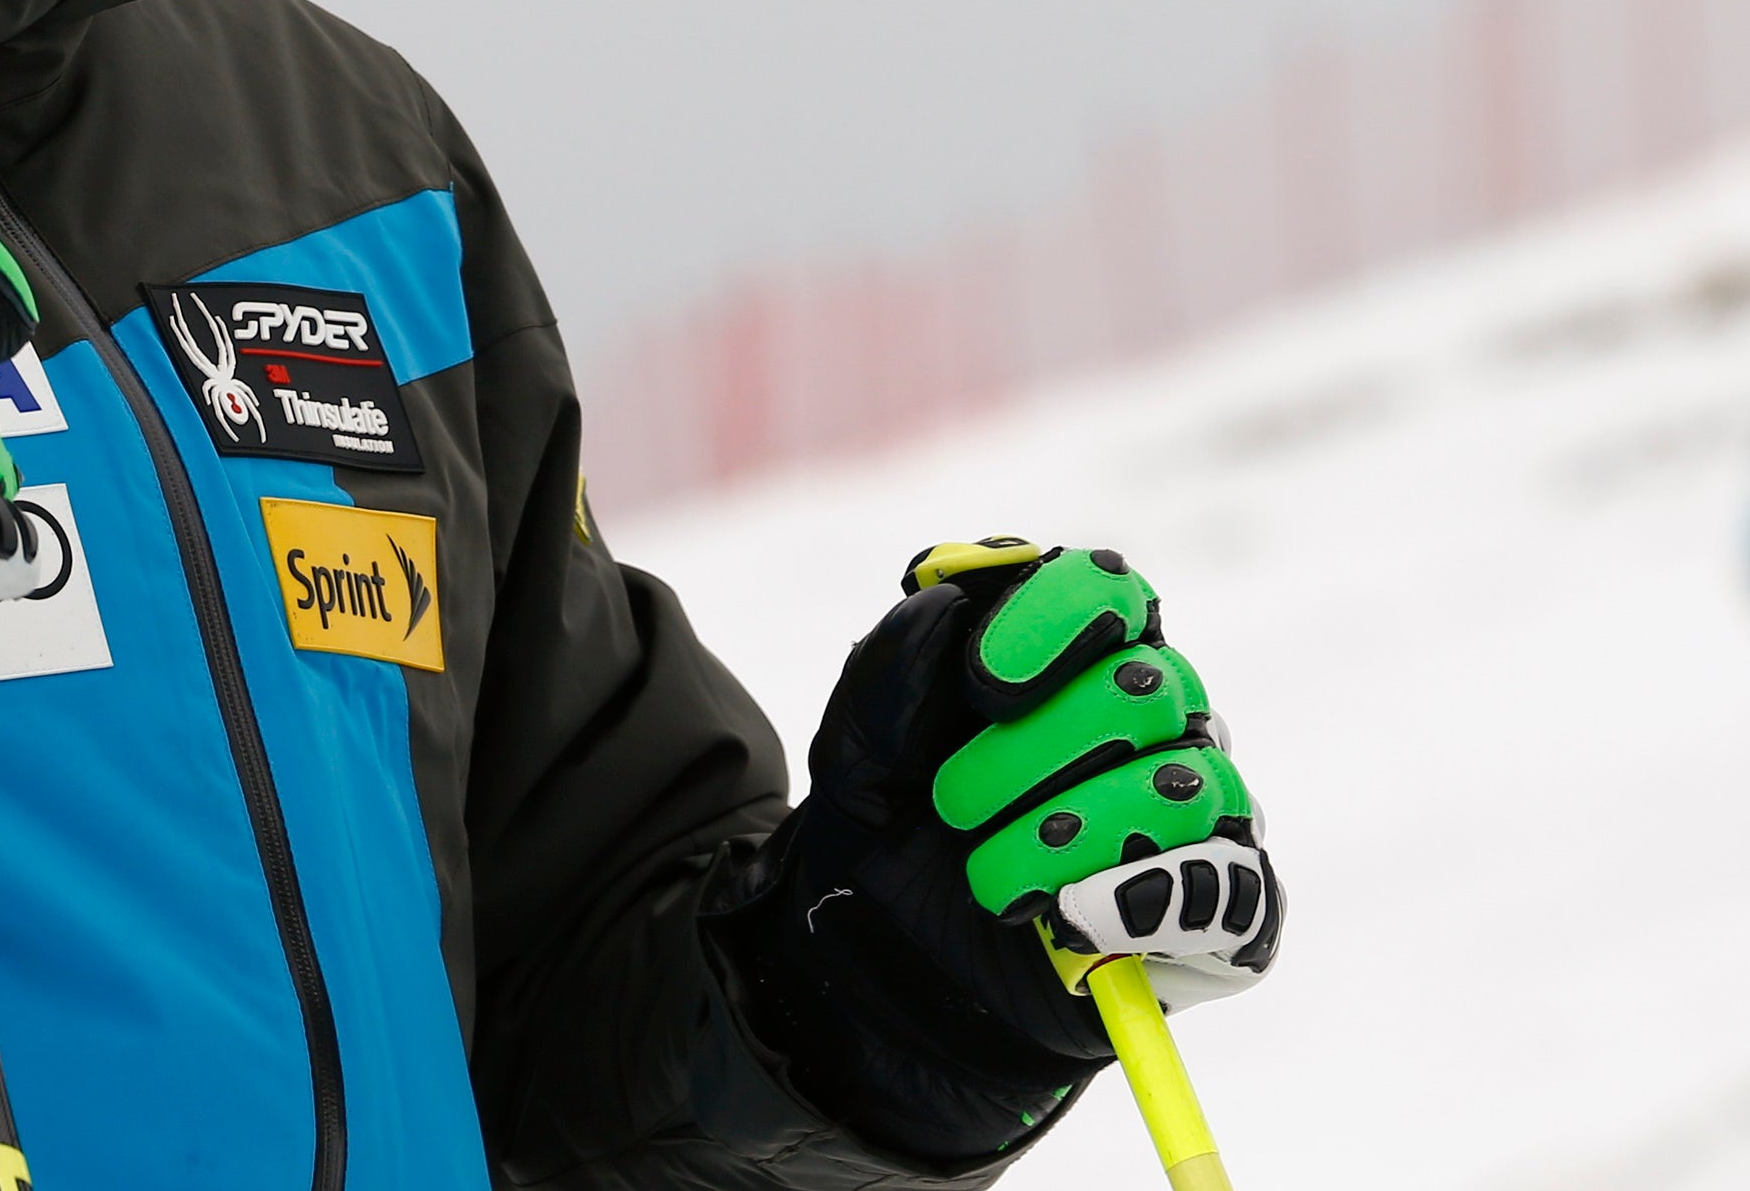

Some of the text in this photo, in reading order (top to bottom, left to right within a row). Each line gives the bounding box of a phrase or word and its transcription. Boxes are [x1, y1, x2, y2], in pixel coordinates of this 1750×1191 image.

[232, 301, 369, 351] SPYDER
[264, 364, 291, 385] 3M
[272, 388, 390, 436] Thinsulate
[332, 434, 394, 454] INSULATION
[286, 549, 392, 629] Sprint
